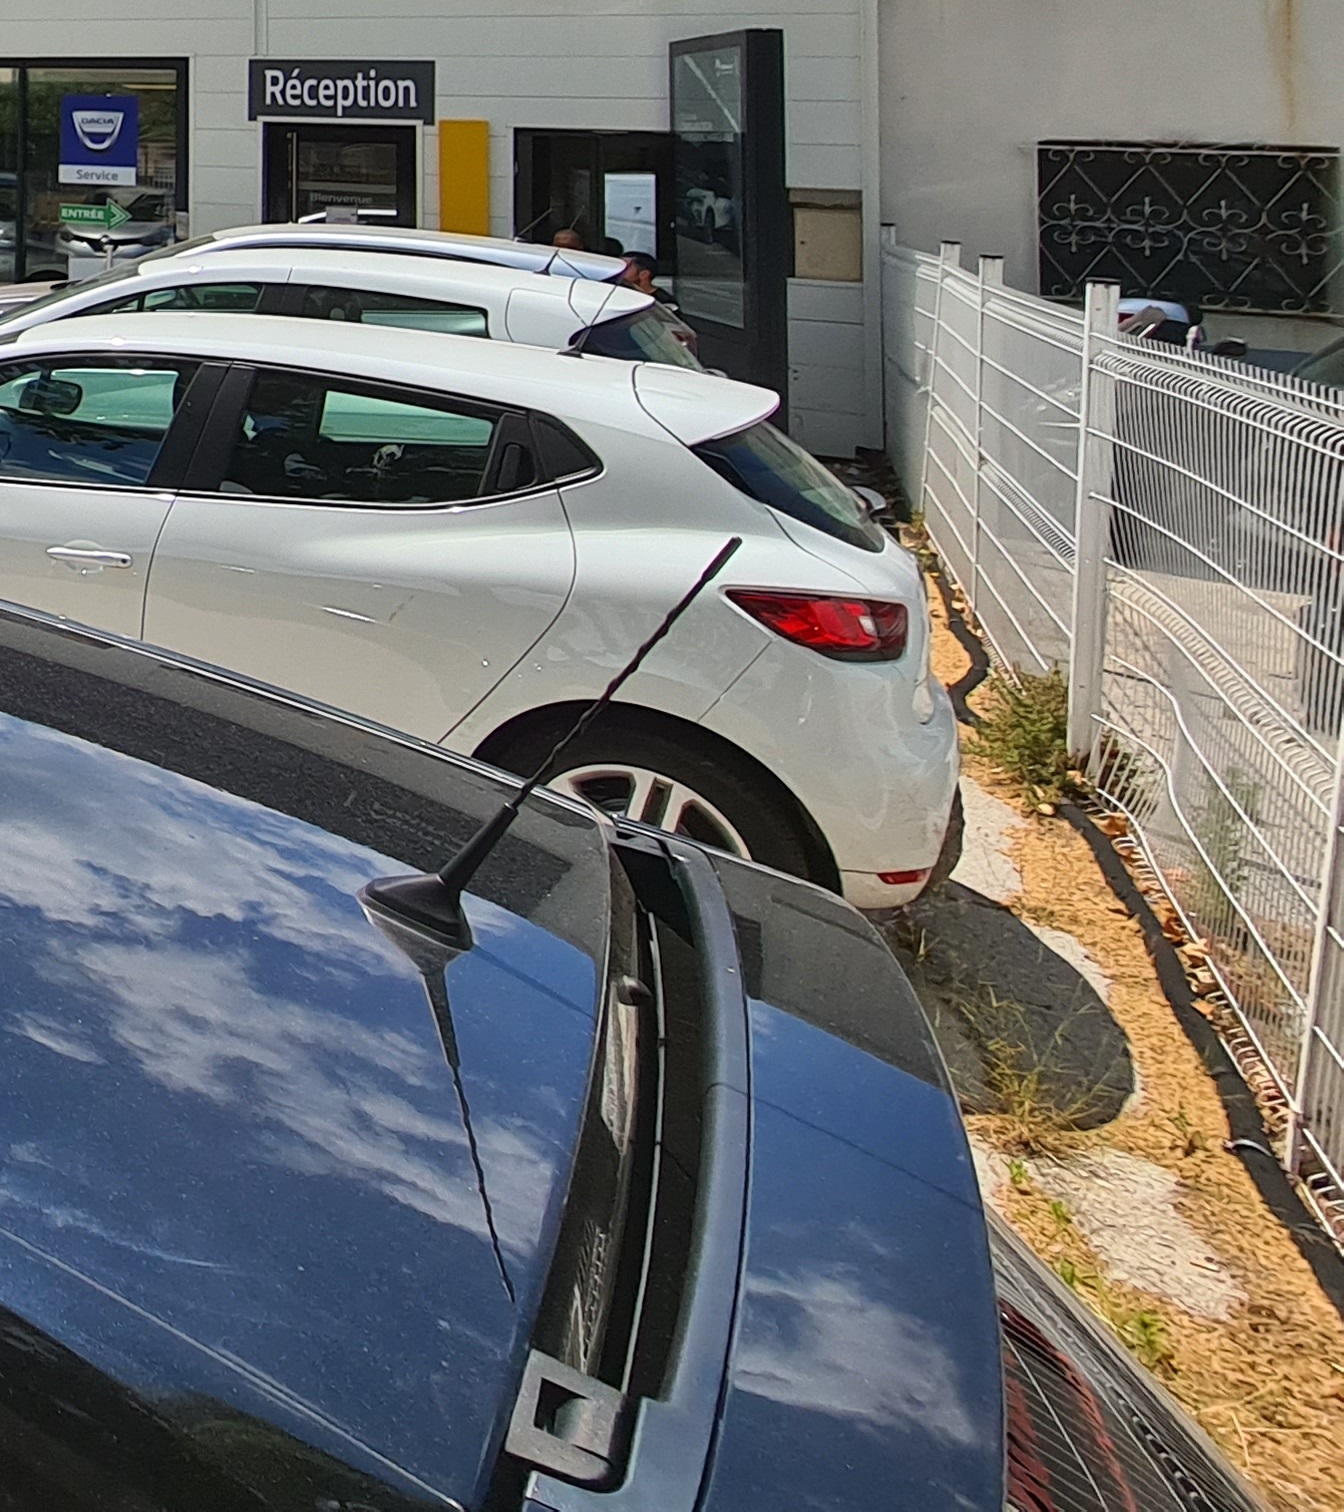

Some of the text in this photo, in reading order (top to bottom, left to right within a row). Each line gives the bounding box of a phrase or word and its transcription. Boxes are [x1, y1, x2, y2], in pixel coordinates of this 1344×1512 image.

[264, 68, 417, 117] Réception
[80, 116, 115, 126] DACIA
[75, 169, 119, 182] Service
[61, 206, 105, 220] ENTRÉE
